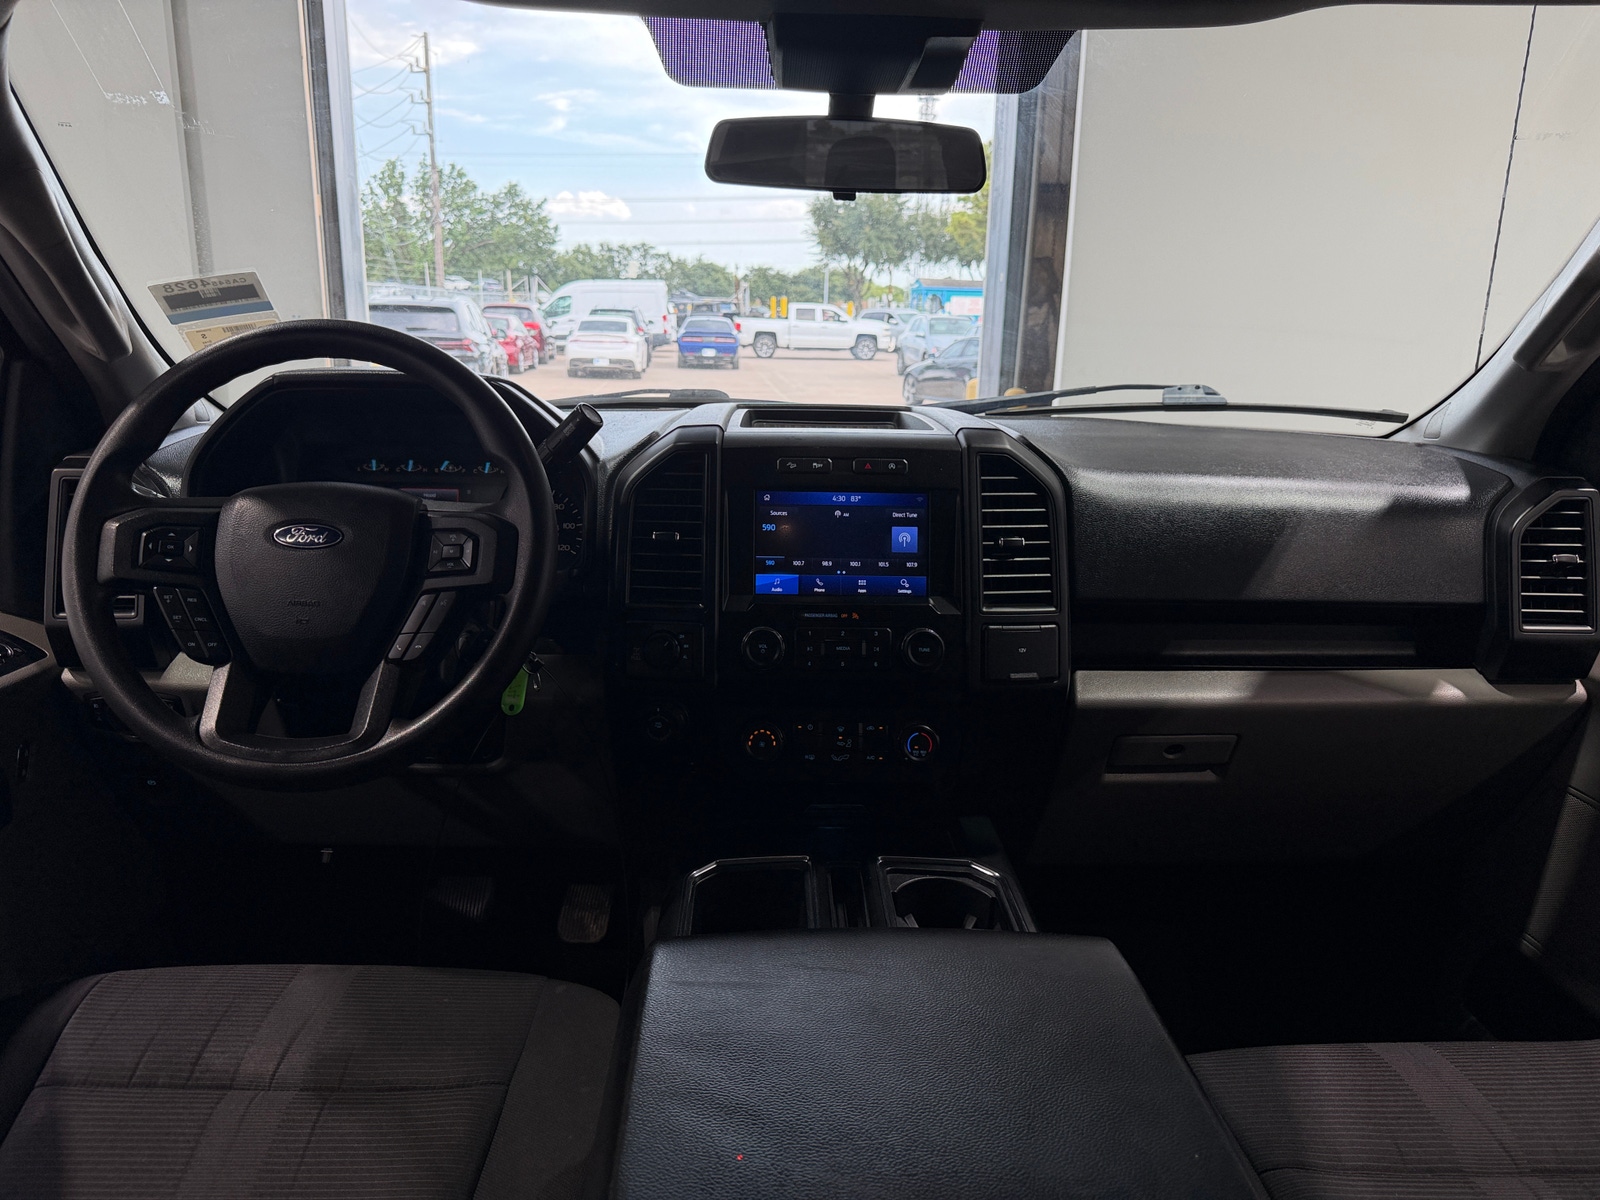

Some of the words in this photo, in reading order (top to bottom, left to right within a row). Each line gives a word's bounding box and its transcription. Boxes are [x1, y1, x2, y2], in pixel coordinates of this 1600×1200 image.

[562, 522, 576, 530] 100
[762, 523, 776, 531] 590
[286, 526, 329, 543] Ford
